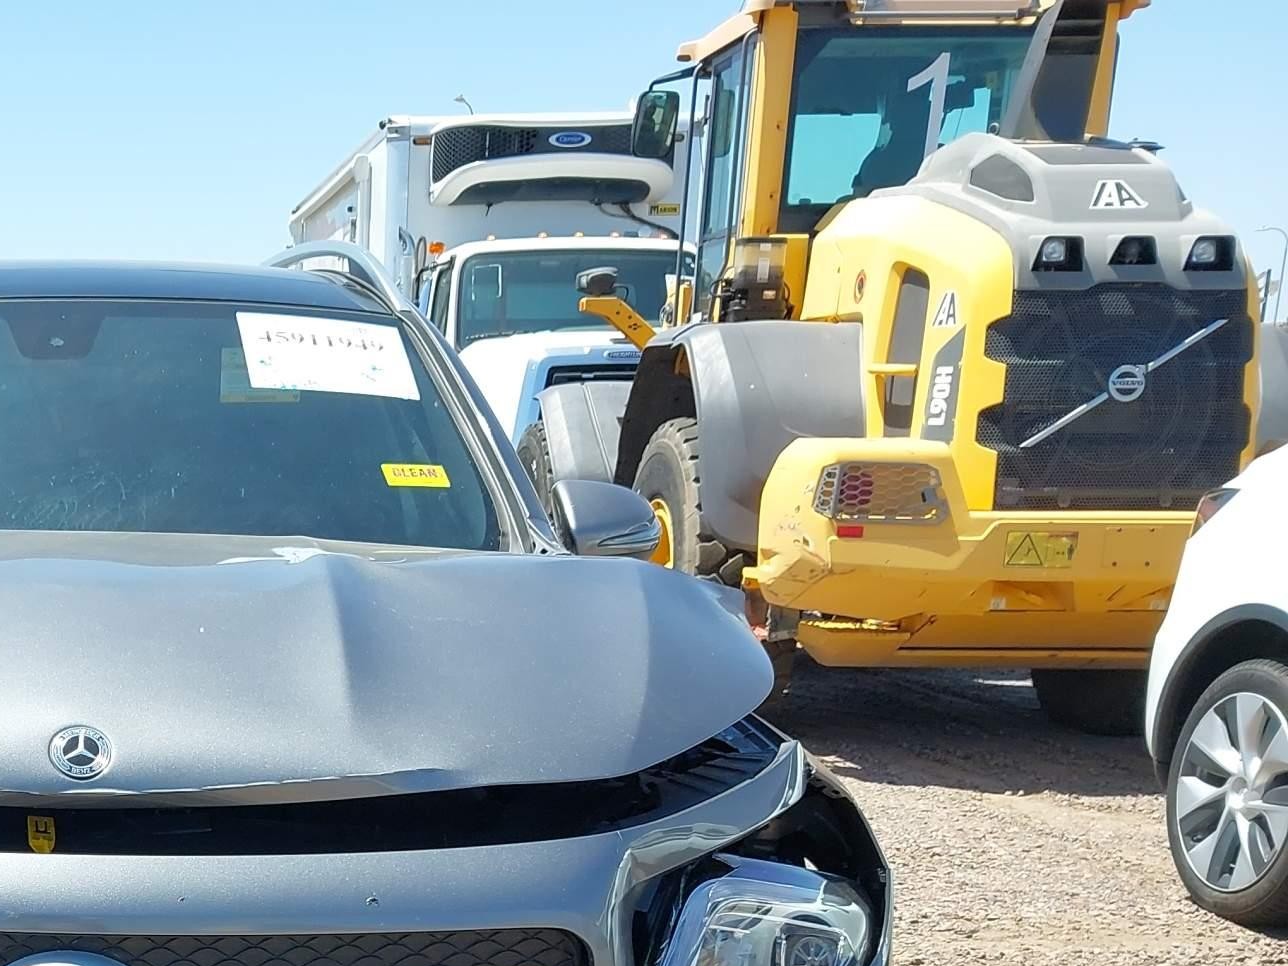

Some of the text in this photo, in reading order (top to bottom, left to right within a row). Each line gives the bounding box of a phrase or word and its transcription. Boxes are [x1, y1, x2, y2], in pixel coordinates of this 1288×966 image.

[907, 52, 950, 159] 1
[928, 365, 954, 426] L90H
[1111, 379, 1144, 387] VOLVO
[392, 467, 438, 478] CLEAN
